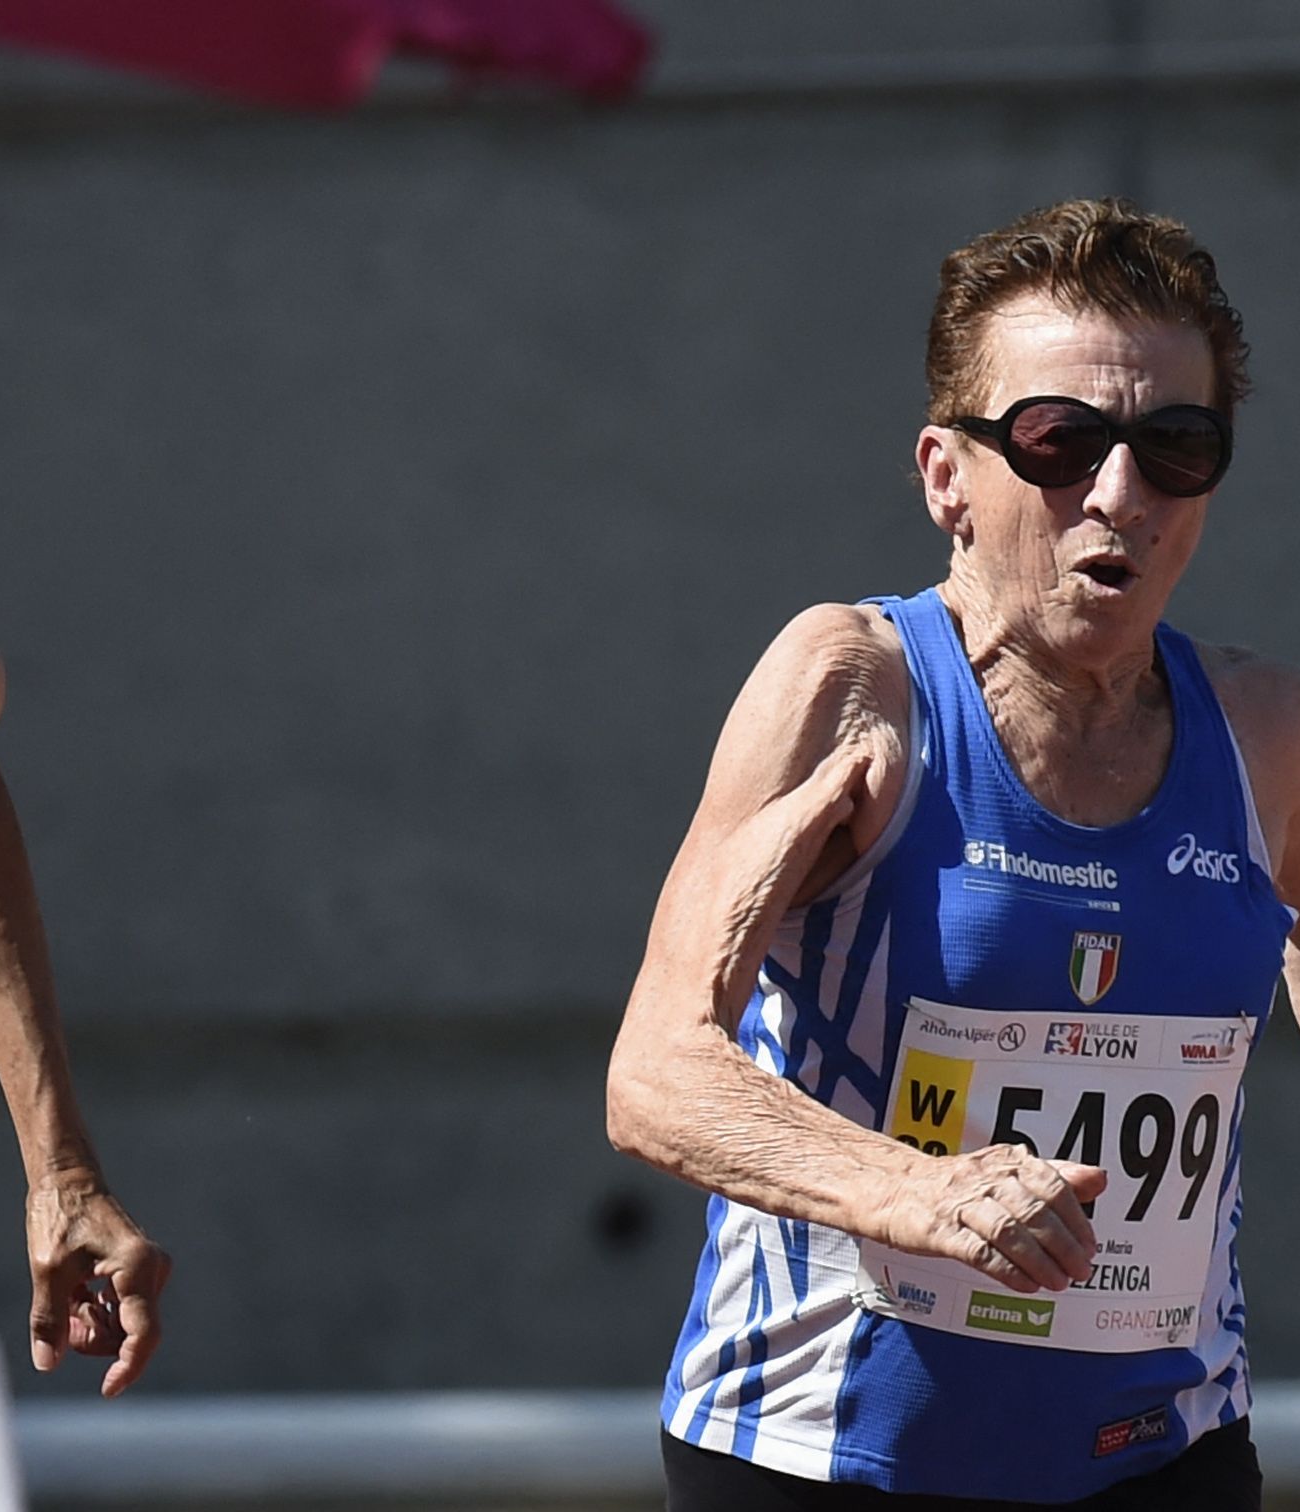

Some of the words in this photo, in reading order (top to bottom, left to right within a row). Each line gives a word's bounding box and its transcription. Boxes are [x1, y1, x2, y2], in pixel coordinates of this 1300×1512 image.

[988, 841, 1118, 890] Findomestic
[1192, 847, 1241, 883] asics
[1077, 934, 1114, 951] FIDAL
[1085, 1023, 1120, 1038] VILLE
[1123, 1025, 1140, 1038] DE
[1080, 1037, 1139, 1060] LYON
[909, 1078, 957, 1128] W
[1105, 1240, 1134, 1255] Maria
[969, 1304, 1023, 1325] erima
